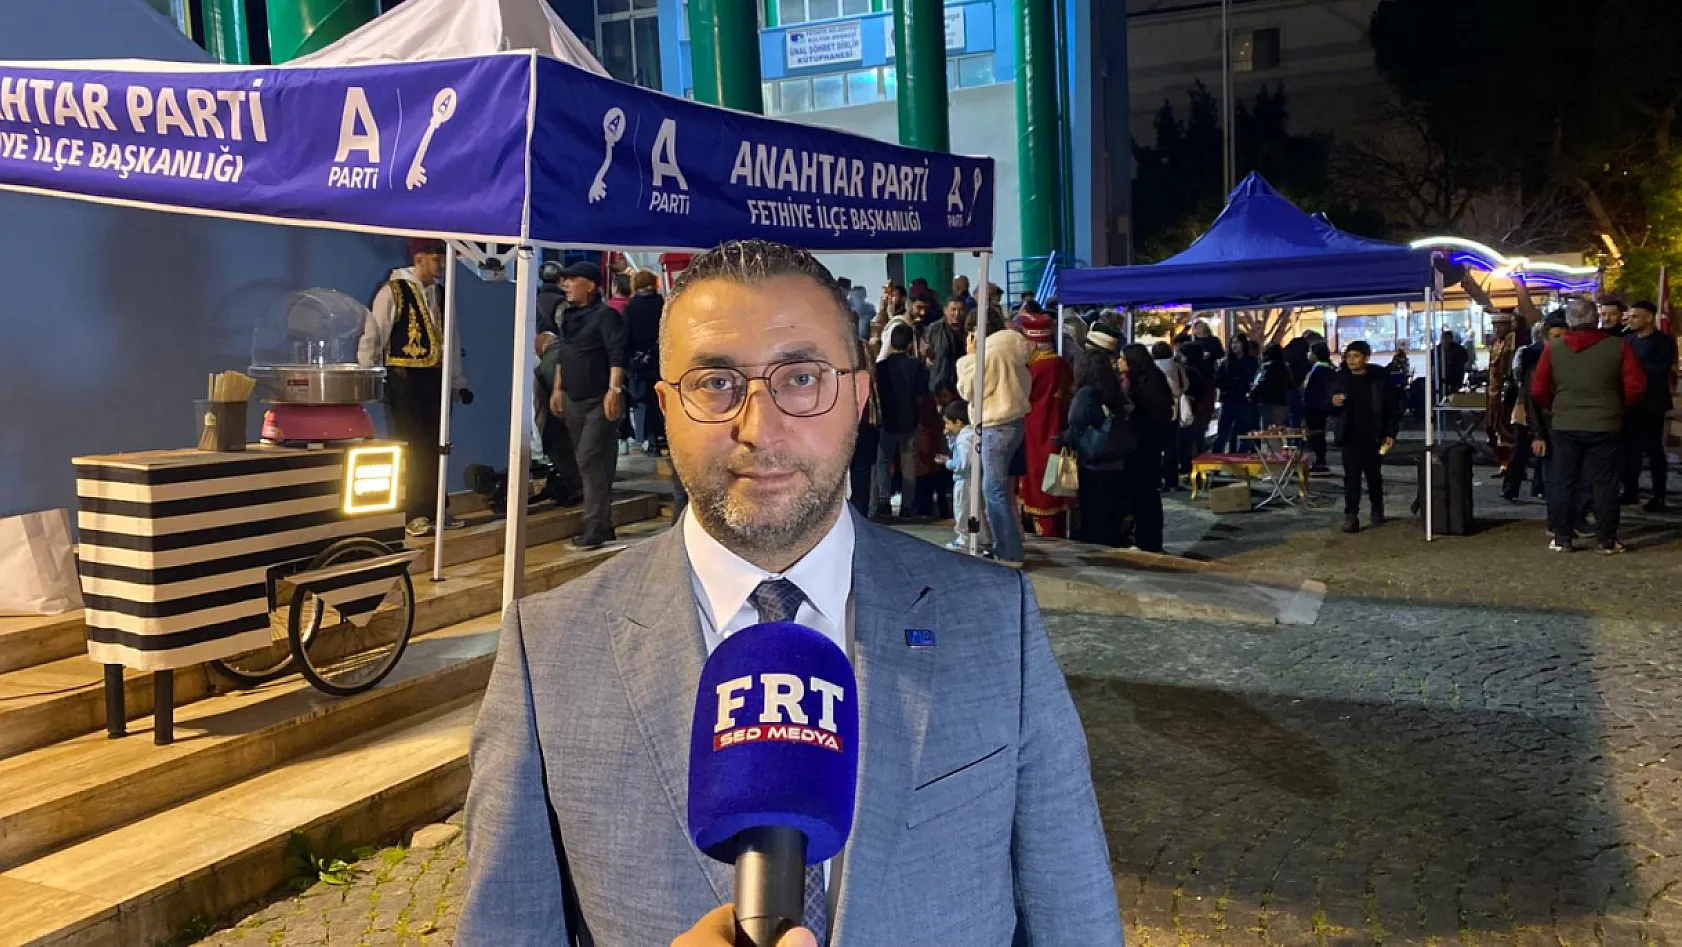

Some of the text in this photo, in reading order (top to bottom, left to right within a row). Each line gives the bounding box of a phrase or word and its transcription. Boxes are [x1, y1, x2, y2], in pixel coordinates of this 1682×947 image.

[0, 76, 268, 142] HTAR PARTİ
[334, 86, 380, 164] A
[33, 128, 84, 171] İLÇE
[89, 141, 243, 183] BAŞKANLIĞI
[651, 118, 689, 190] A
[730, 140, 929, 202] ANAHTAR PARTİ
[747, 196, 922, 236] FETHİYE İLÇE BAŞKANLIĞI
[947, 166, 964, 212] A
[713, 673, 845, 734] FRT
[719, 726, 840, 750] SED MEDYA
